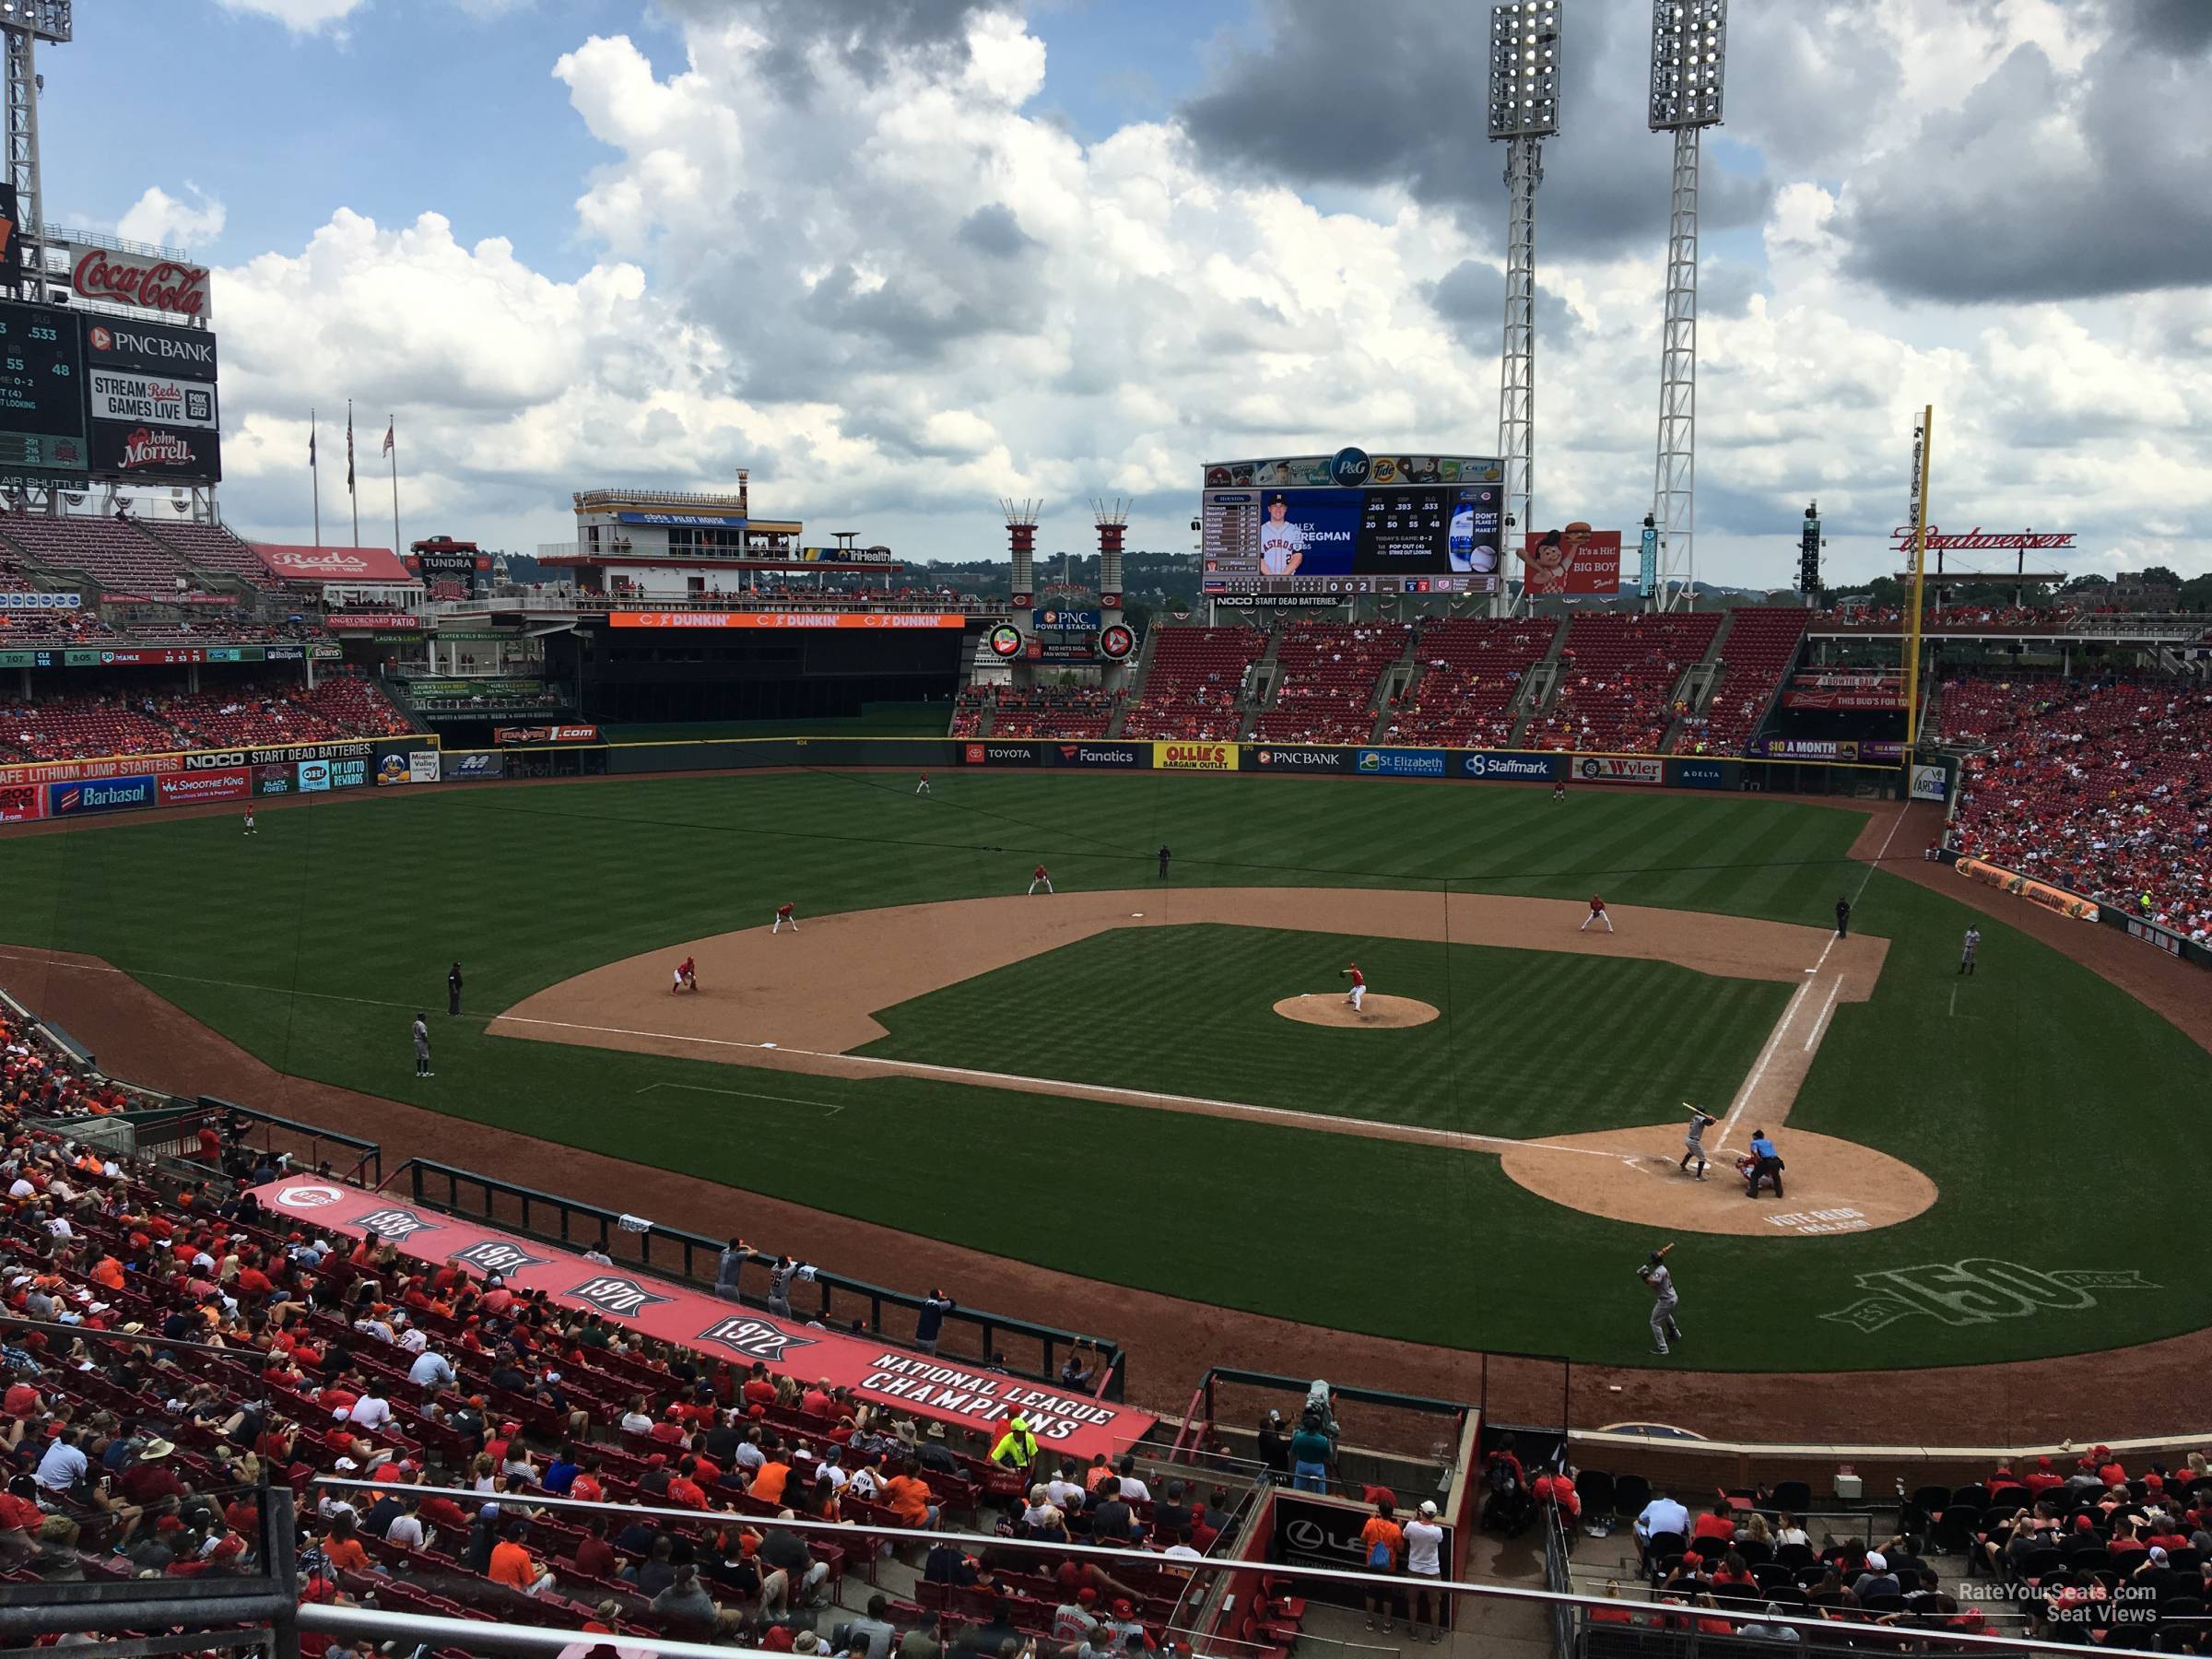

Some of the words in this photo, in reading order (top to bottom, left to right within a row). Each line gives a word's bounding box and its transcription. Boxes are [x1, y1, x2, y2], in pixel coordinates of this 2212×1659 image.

[74, 250, 210, 314] Coca-Cola
[28, 326, 57, 341] .533
[7, 358, 24, 371] 55
[52, 364, 70, 376] 48
[95, 377, 147, 398] STREAM
[148, 382, 183, 403] Reds
[6, 399, 36, 410] LOOKING
[188, 394, 206, 405] FOX
[109, 397, 152, 417] GAMES
[156, 403, 181, 419] LIVE
[190, 406, 207, 418] GO
[146, 430, 176, 444] John
[118, 441, 196, 468] Morrell
[1339, 460, 1366, 475] P&G
[1373, 462, 1395, 479] Tide
[1, 475, 23, 487] AIR
[26, 477, 83, 489] SHUTTLE
[672, 515, 696, 524] PILOT
[697, 516, 727, 524] HOUSE
[1294, 523, 1315, 531] ALEX
[1296, 532, 1351, 542] BREGMAN
[1264, 539, 1293, 552] ASTROS
[1579, 547, 1593, 555] It's
[1600, 547, 1616, 555] Hit!
[272, 552, 368, 569] Reds
[849, 549, 891, 562] TriHealth
[424, 558, 472, 569] TUNDRA
[1573, 562, 1593, 571] BIG
[1594, 562, 1616, 571] BOY
[1330, 582, 1337, 591] 0
[1345, 582, 1353, 591] 0
[1359, 582, 1368, 591] 2
[1217, 597, 1253, 606] NOCO
[1255, 597, 1278, 606] START
[1278, 597, 1298, 606] DEAD
[1300, 597, 1339, 606] BATTERIES.
[391, 618, 415, 627] PATIO
[671, 614, 730, 626] DUNKIN'
[787, 614, 839, 626] DUNKIN'
[889, 614, 940, 626] DUNKIN'
[1059, 612, 1088, 624] PNC
[375, 634, 402, 642] LAURA'S
[178, 654, 187, 663] 53
[276, 650, 303, 660] Ballpark
[315, 648, 340, 657] Evans
[1828, 677, 1855, 686] BOWTIE
[1858, 677, 1875, 686] BAR
[1837, 697, 1854, 705] THIS
[1856, 697, 1879, 705] BUD'S
[1880, 698, 1896, 706] FOR
[1897, 698, 1910, 706] YO
[988, 749, 1031, 759] TOYOTA
[1786, 741, 1796, 752] A
[1796, 741, 1837, 754] MONTH
[1079, 749, 1134, 762] Fanatics
[1394, 756, 1443, 768] Elizabeth
[0, 769, 23, 783] AFE
[29, 765, 80, 782] LITHIUM
[83, 762, 115, 778] JUMP
[120, 758, 182, 775] STARTERS.
[186, 752, 245, 770] NOCO
[252, 749, 287, 763] START
[288, 747, 318, 761] DEAD
[319, 743, 373, 759] BATTERIES.
[331, 762, 344, 774] MY
[344, 760, 365, 773] LOTTO
[414, 759, 437, 768] Valley
[1199, 761, 1229, 770] OUTLET
[1488, 759, 1548, 775] Staffmark
[1607, 759, 1660, 777] Wyler
[303, 769, 324, 779] OH!
[334, 772, 363, 787] REWARDS
[1691, 771, 1720, 779] DELTA
[179, 778, 223, 792] SMOOTHIE
[223, 776, 244, 786] KING
[263, 784, 288, 793] FOREST
[265, 779, 287, 787] BLACK
[1916, 780, 1933, 793] ARC
[83, 784, 146, 807] Barbasol
[294, 1191, 335, 1206] REDS
[1761, 1212, 1818, 1227] VOTE
[1808, 1207, 1865, 1222] REDS
[360, 1211, 419, 1237] 1939
[465, 1243, 524, 1272] 1961
[577, 1279, 646, 1311] 1970
[1854, 1257, 2099, 1326] 150
[712, 1320, 788, 1354] 1972
[871, 1353, 998, 1395] NATIONAL
[1002, 1386, 1116, 1426] LEAGUE
[861, 1371, 1079, 1440] CHAMPINS
